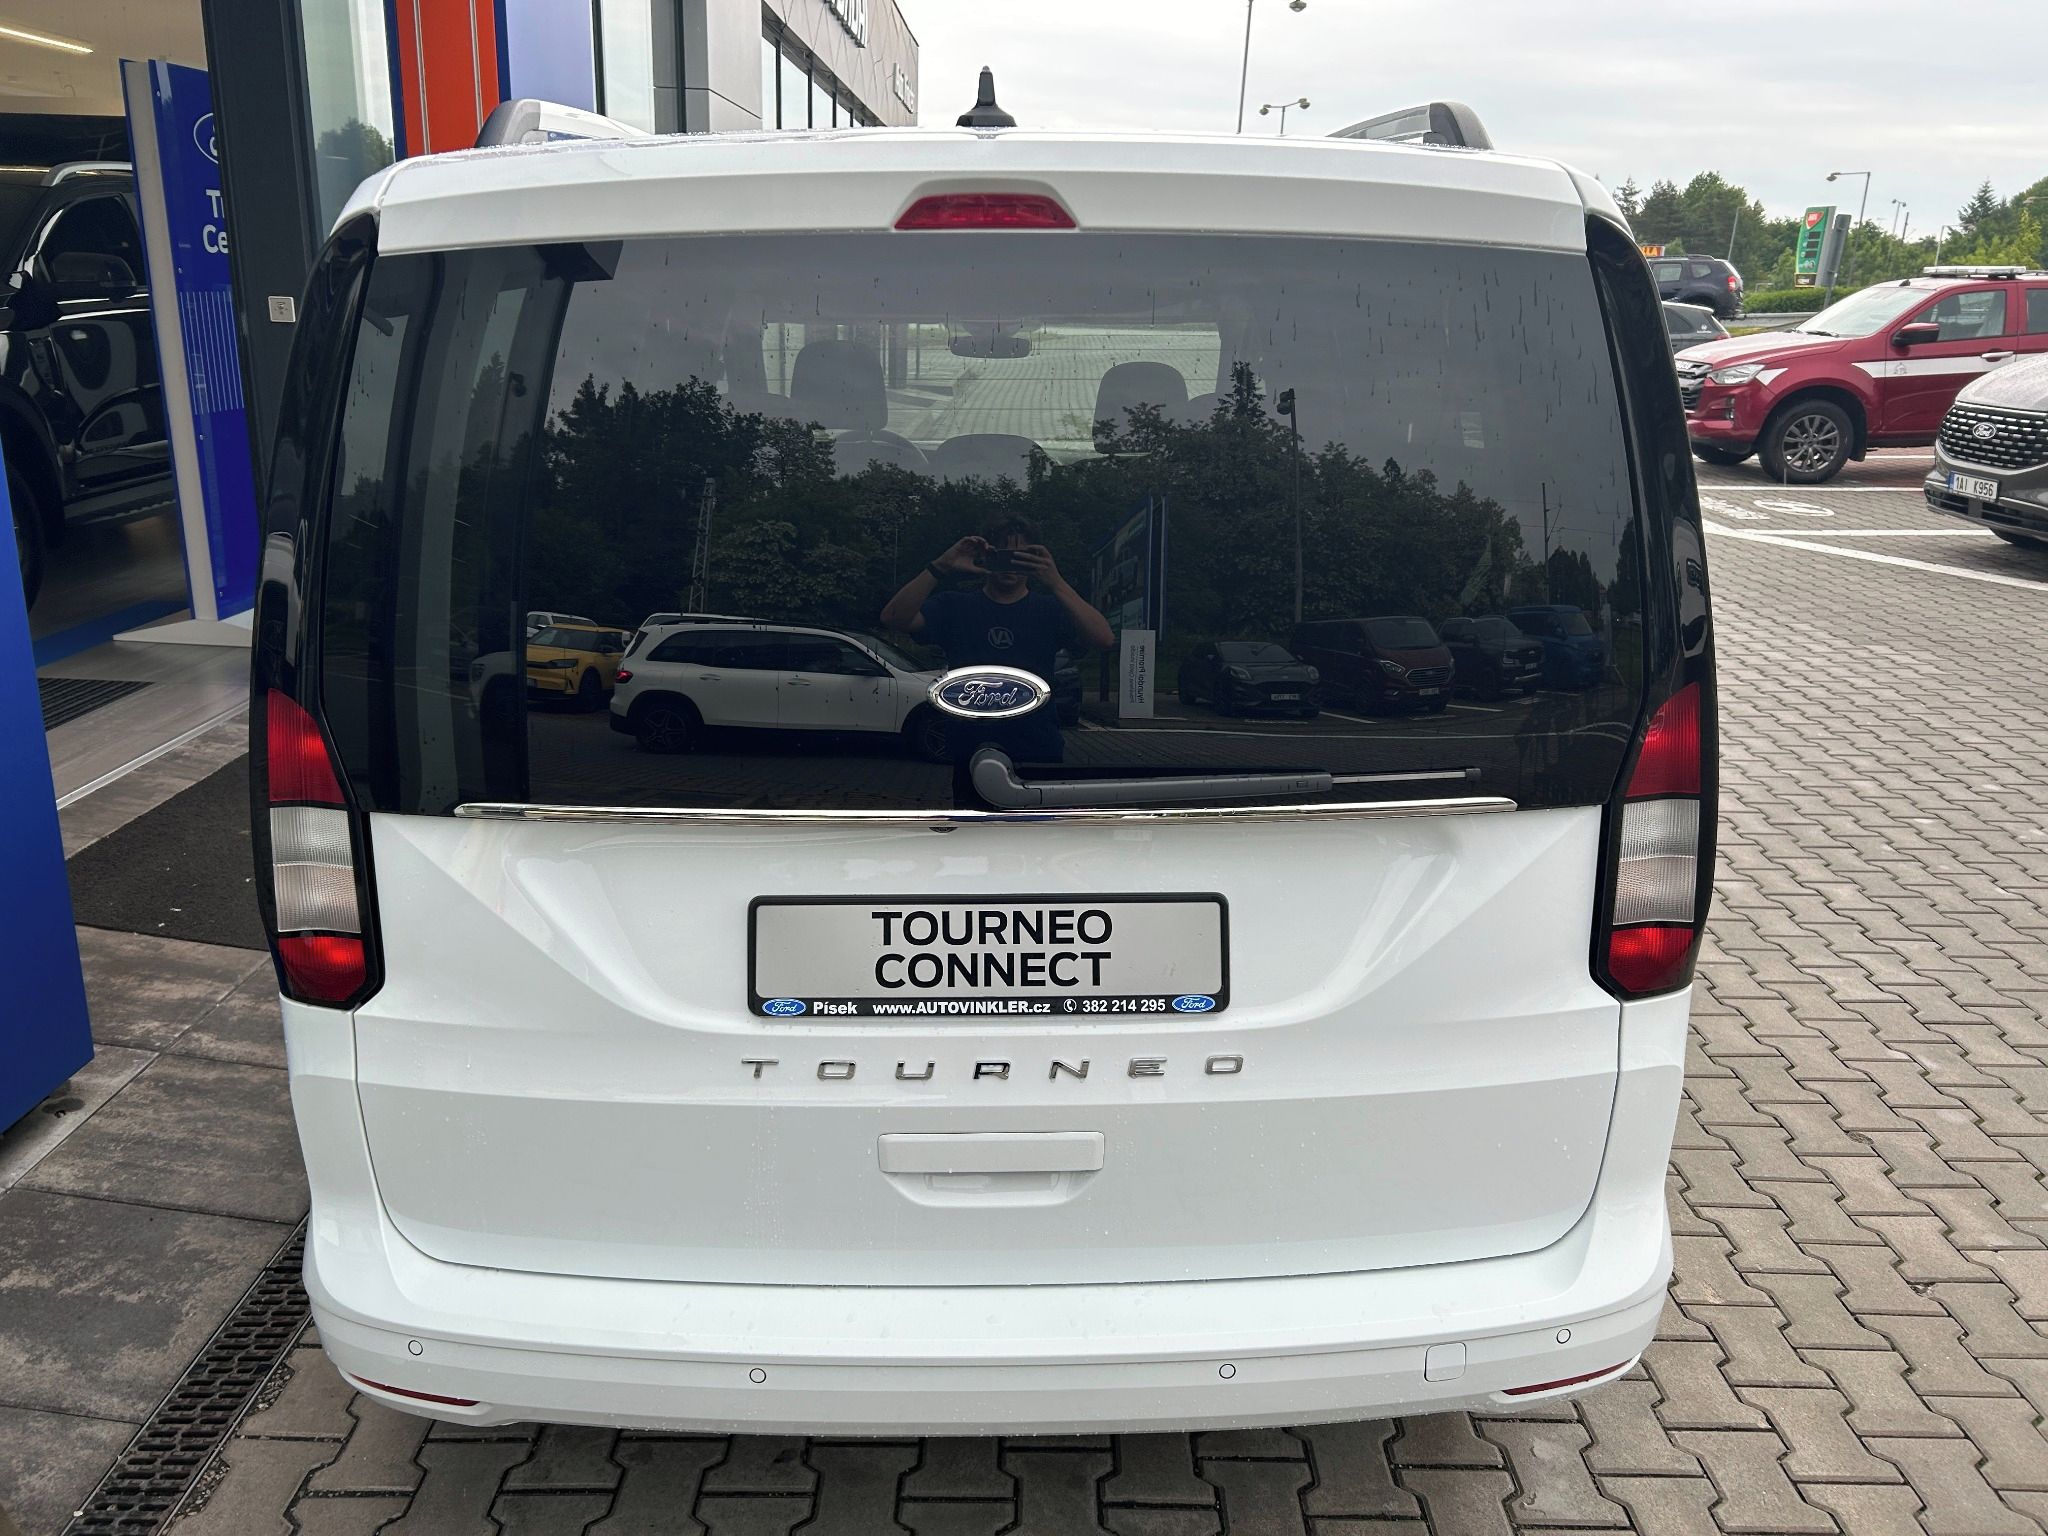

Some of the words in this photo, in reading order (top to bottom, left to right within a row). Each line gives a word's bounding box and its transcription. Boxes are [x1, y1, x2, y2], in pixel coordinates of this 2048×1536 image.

[205, 188, 225, 219] T
[1956, 476, 1968, 492] 1AI
[1974, 480, 1994, 497] K956
[957, 680, 1017, 706] Ford
[871, 909, 1113, 946] TOURNEO
[874, 951, 1112, 989] CONNECT
[813, 1001, 858, 1015] Písek
[873, 1000, 1051, 1014] www.AUTOVINKLER.cz
[1082, 1000, 1108, 1013] 382
[1111, 1000, 1137, 1013] 214
[1140, 999, 1166, 1012] 295
[741, 1053, 1245, 1081] TOURNEO
